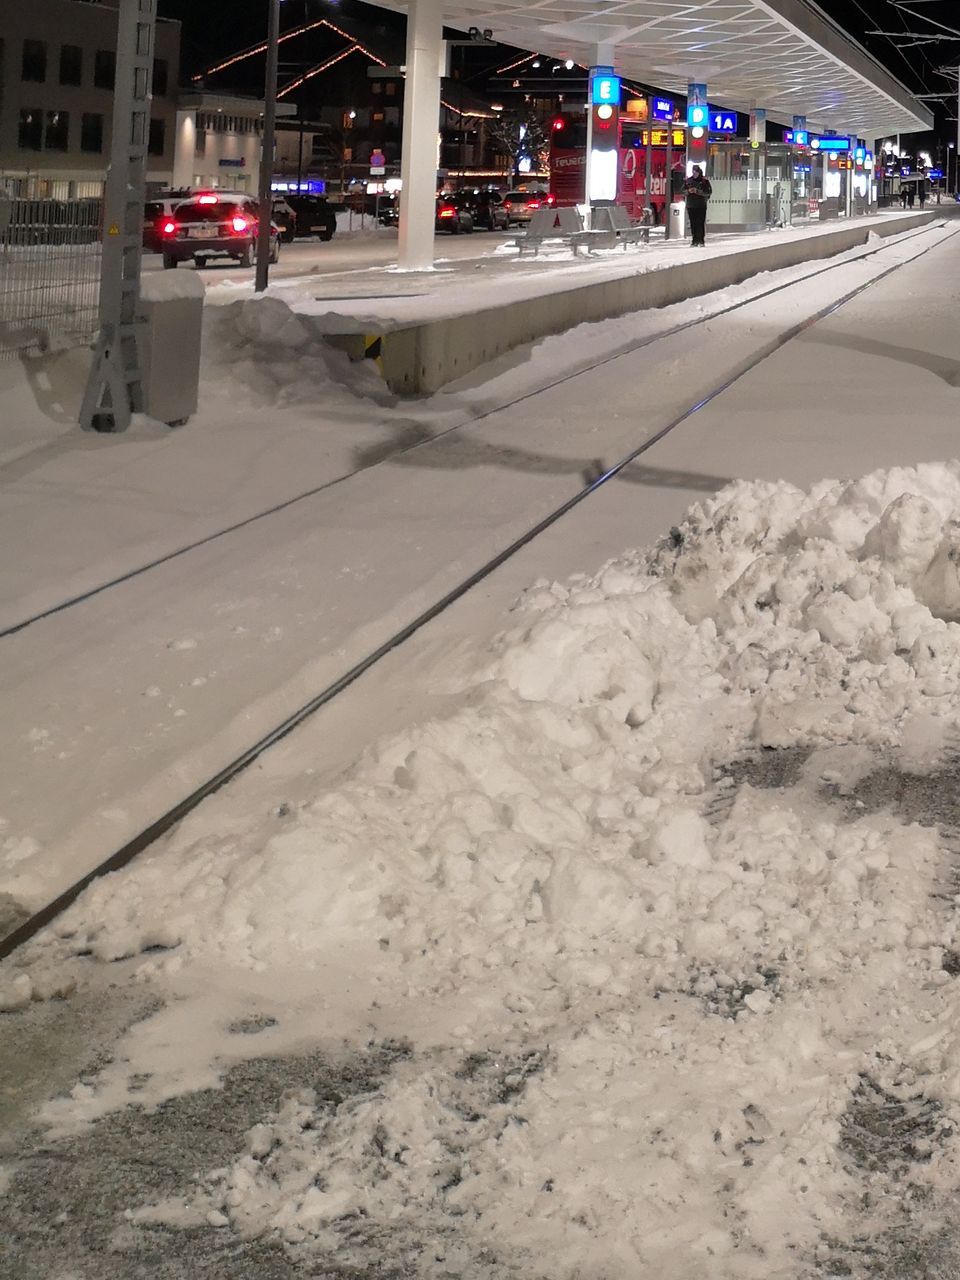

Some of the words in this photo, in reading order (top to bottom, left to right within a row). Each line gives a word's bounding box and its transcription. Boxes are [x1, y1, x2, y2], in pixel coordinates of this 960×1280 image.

[600, 80, 612, 100] E
[692, 107, 704, 123] D
[714, 115, 734, 130] 1A
